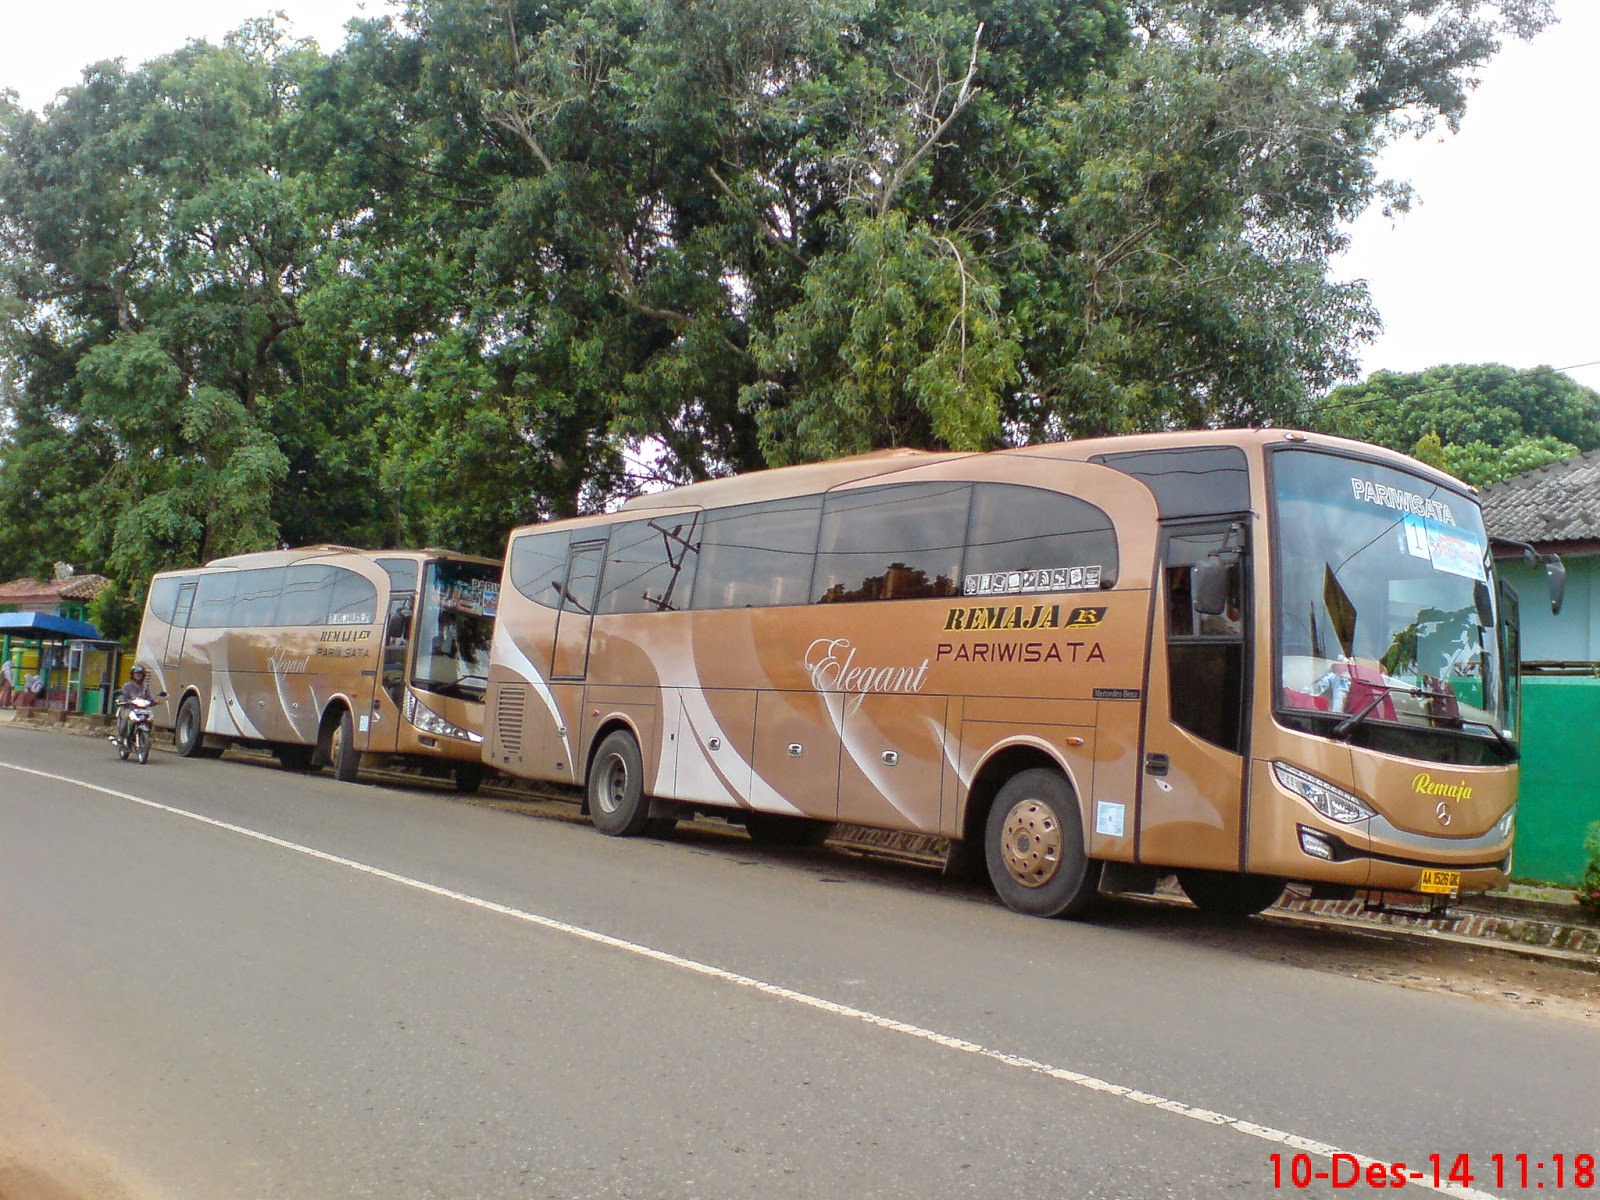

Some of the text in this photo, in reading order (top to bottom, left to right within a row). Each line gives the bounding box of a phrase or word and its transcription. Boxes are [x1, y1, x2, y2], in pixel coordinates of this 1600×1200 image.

[1351, 478, 1456, 526] PARIWISATA
[944, 604, 1060, 631] REMAJA
[320, 630, 357, 643] REMAJA
[936, 642, 1105, 663] PARIWISATA
[804, 638, 929, 718] Elegant
[1412, 773, 1472, 803] Remaja
